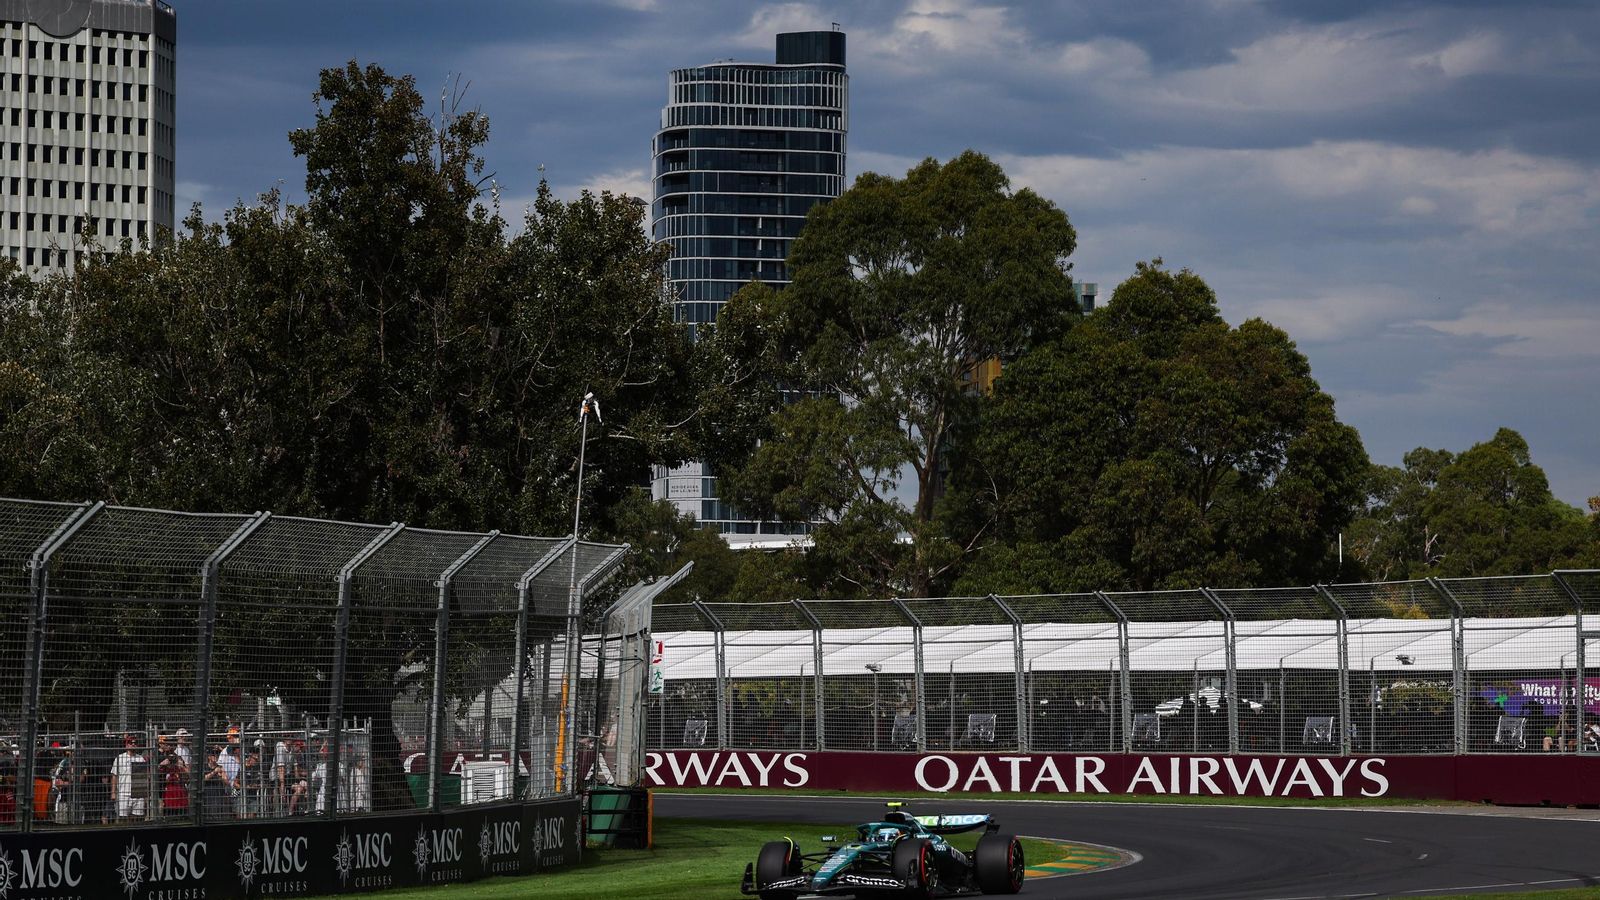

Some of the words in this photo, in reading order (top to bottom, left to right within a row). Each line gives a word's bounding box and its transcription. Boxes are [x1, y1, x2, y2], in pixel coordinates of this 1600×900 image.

[1521, 683, 1557, 697] What
[585, 752, 809, 787] ARWAYS
[914, 755, 1110, 794] QATAR
[1126, 756, 1389, 797] AIRWAYS
[432, 828, 463, 864] MSC
[493, 820, 521, 855] MSC
[544, 816, 565, 850] MSC
[149, 841, 207, 882] MSC
[261, 836, 308, 875] MSC
[355, 832, 392, 869] MSC
[492, 860, 520, 873] CRUISES
[20, 848, 83, 889] MSC
[355, 876, 392, 888] CRUISES
[431, 869, 463, 881] CRUISES
[845, 874, 900, 888] aramco
[148, 887, 207, 900] CRUISES
[261, 881, 308, 894] CRUISES
